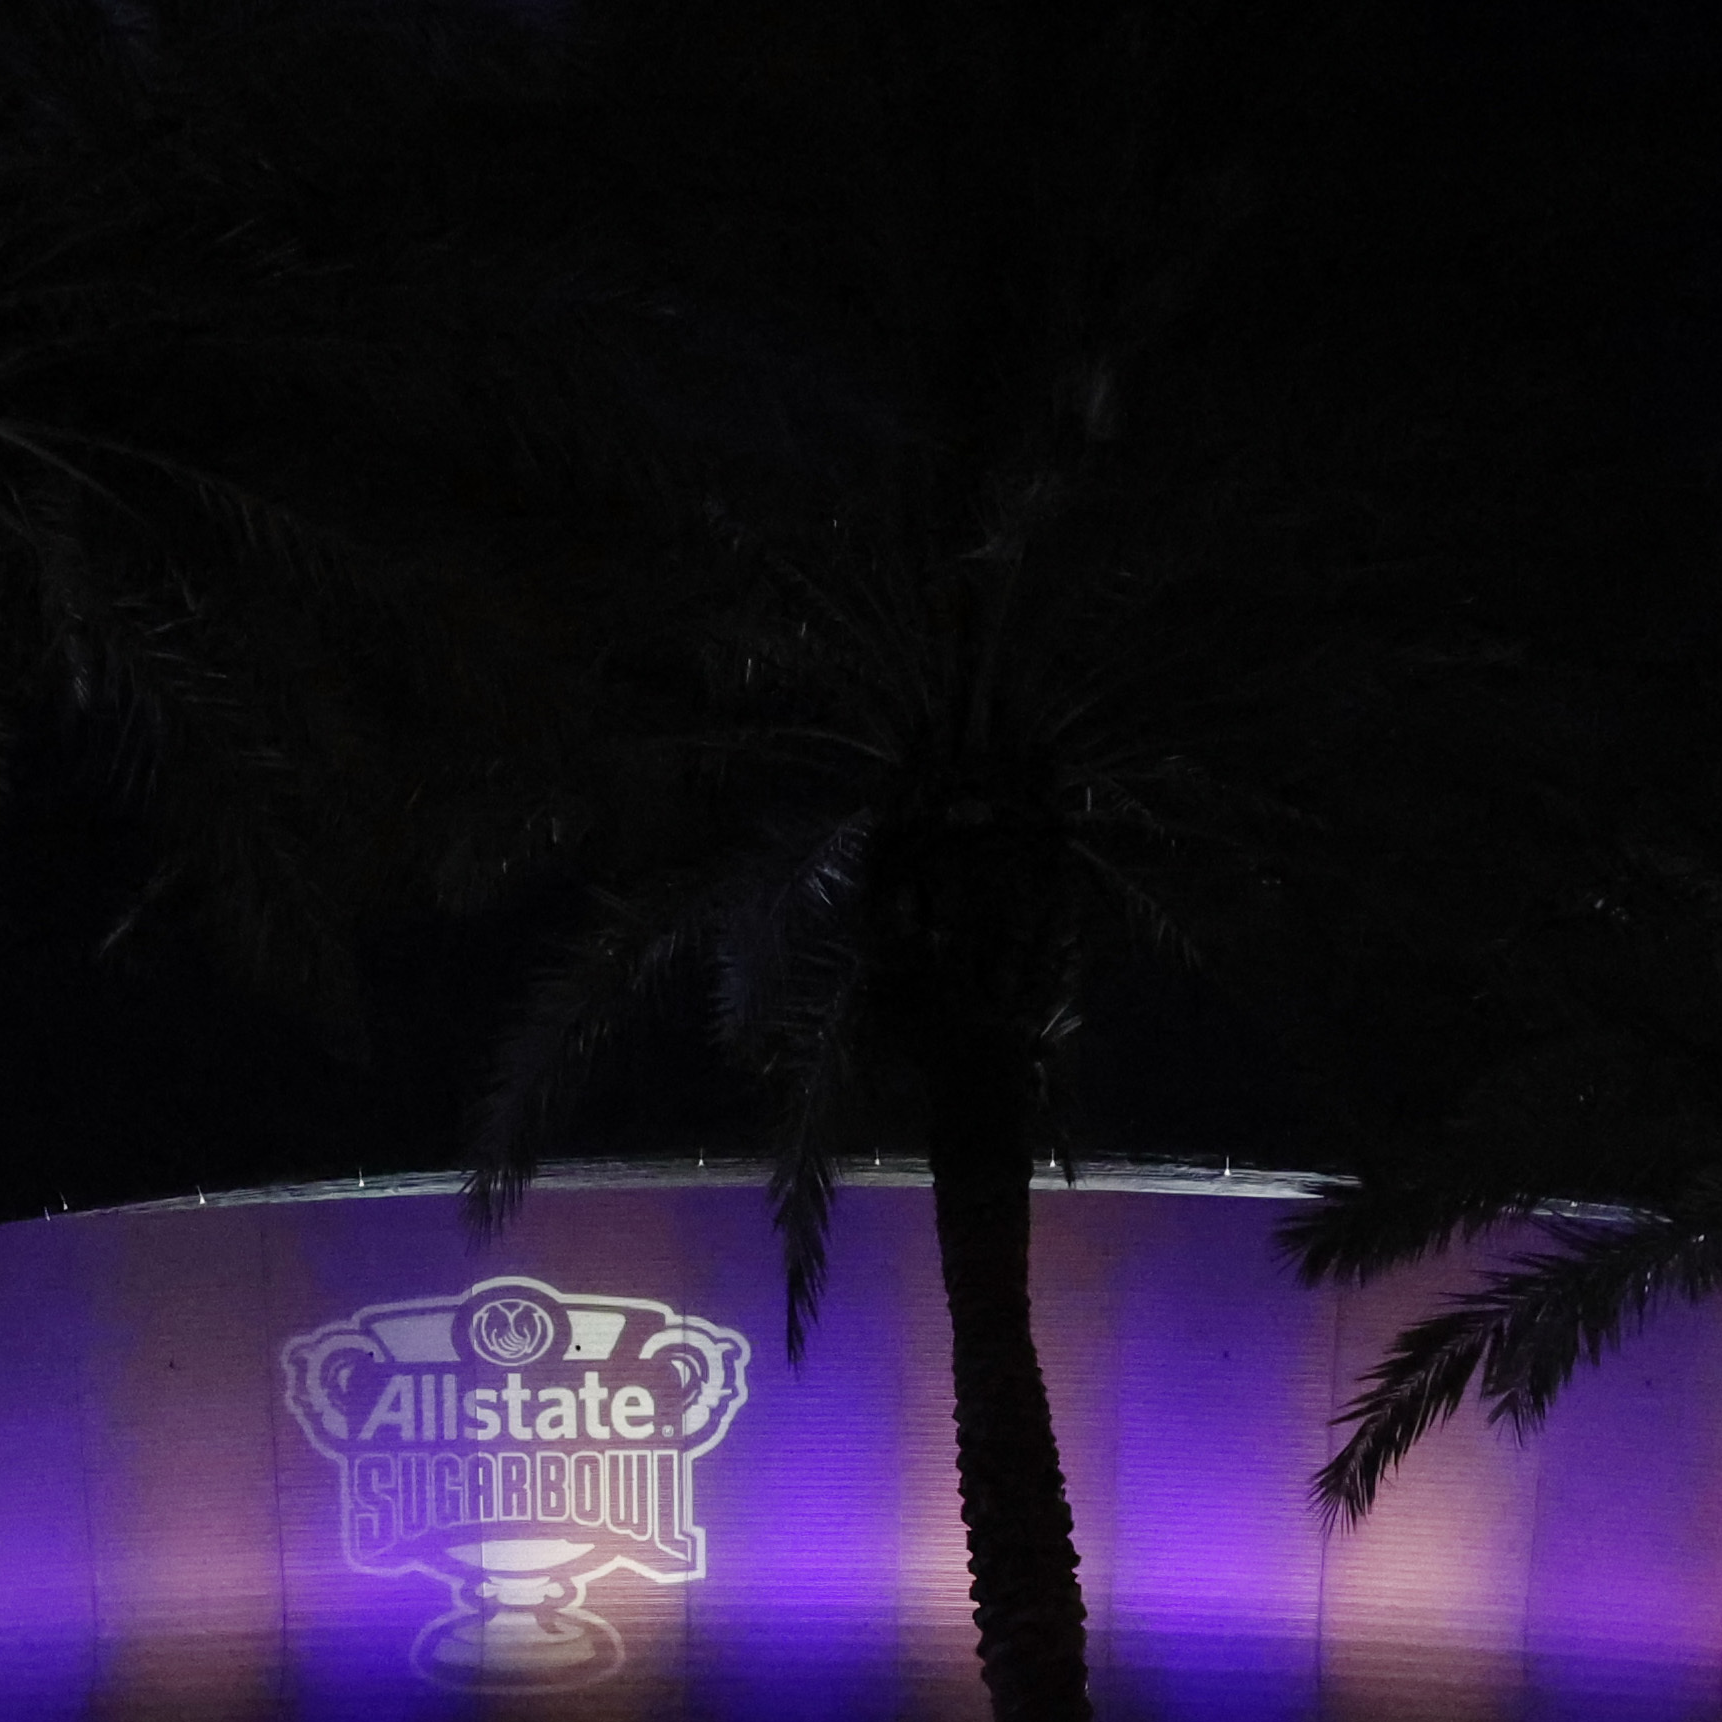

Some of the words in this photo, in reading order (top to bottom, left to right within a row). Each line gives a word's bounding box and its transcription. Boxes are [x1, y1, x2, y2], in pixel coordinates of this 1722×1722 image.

[357, 1372, 656, 1440] Allstate
[354, 1451, 532, 1554] SUGAR
[536, 1450, 693, 1563] BOWL
